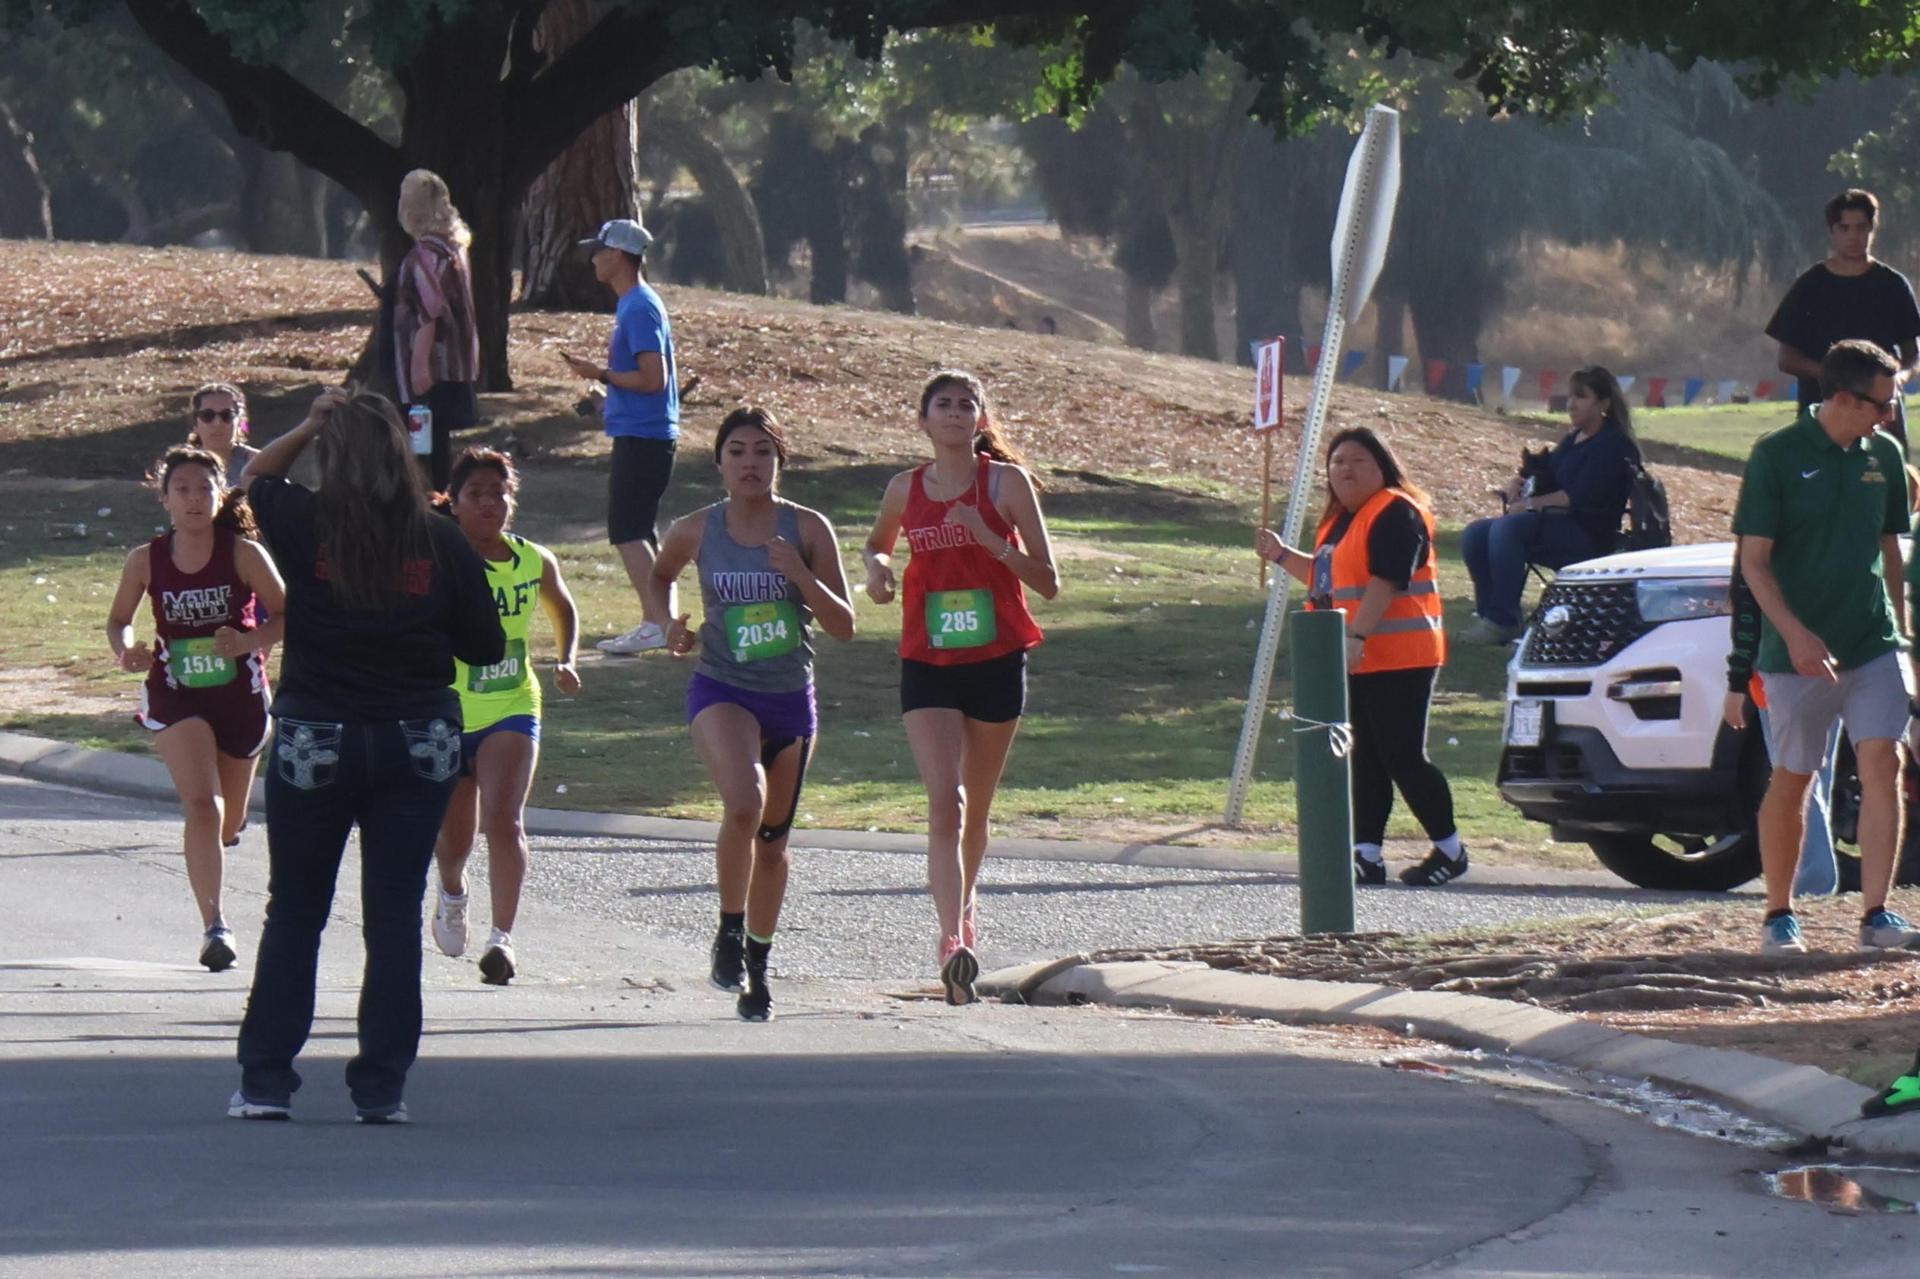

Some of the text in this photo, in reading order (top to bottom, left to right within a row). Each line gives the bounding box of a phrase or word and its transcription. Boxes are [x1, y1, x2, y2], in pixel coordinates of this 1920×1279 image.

[713, 572, 787, 602] WUHS
[940, 611, 978, 632] 285
[737, 619, 787, 648] 2034
[182, 655, 225, 674] 1514
[480, 658, 518, 680] 1920
